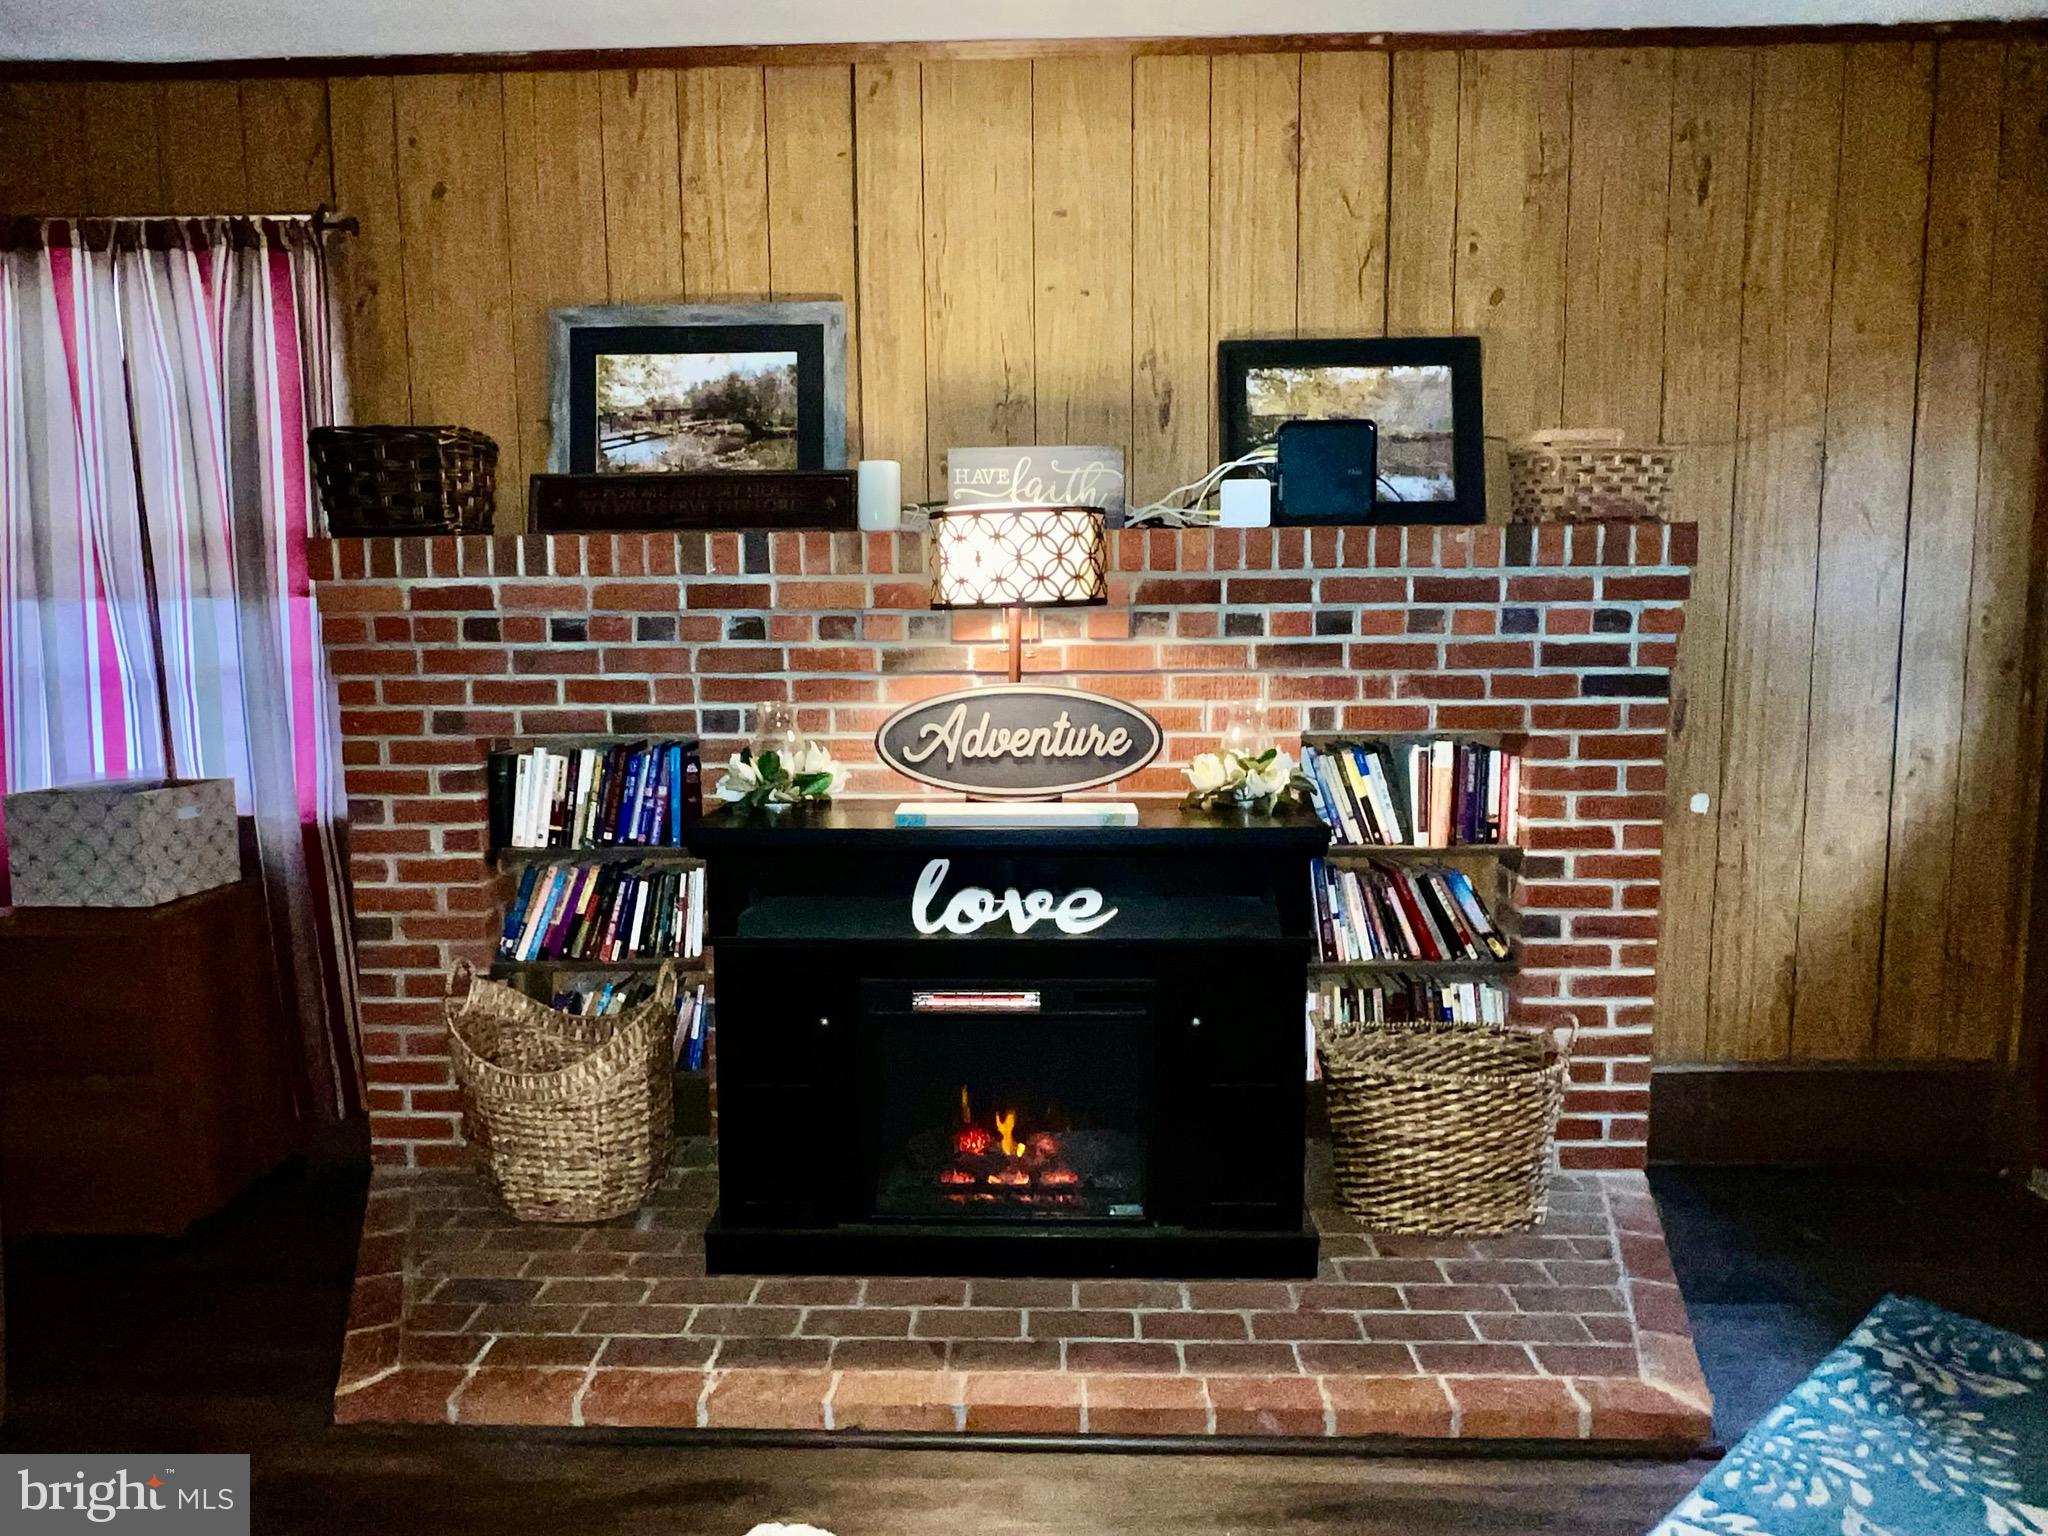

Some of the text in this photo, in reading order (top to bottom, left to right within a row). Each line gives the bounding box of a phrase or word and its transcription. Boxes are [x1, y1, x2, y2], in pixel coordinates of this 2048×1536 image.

[953, 456, 1123, 507] HAVE faith
[903, 703, 1132, 763] Adventure
[911, 858, 1119, 934] love
